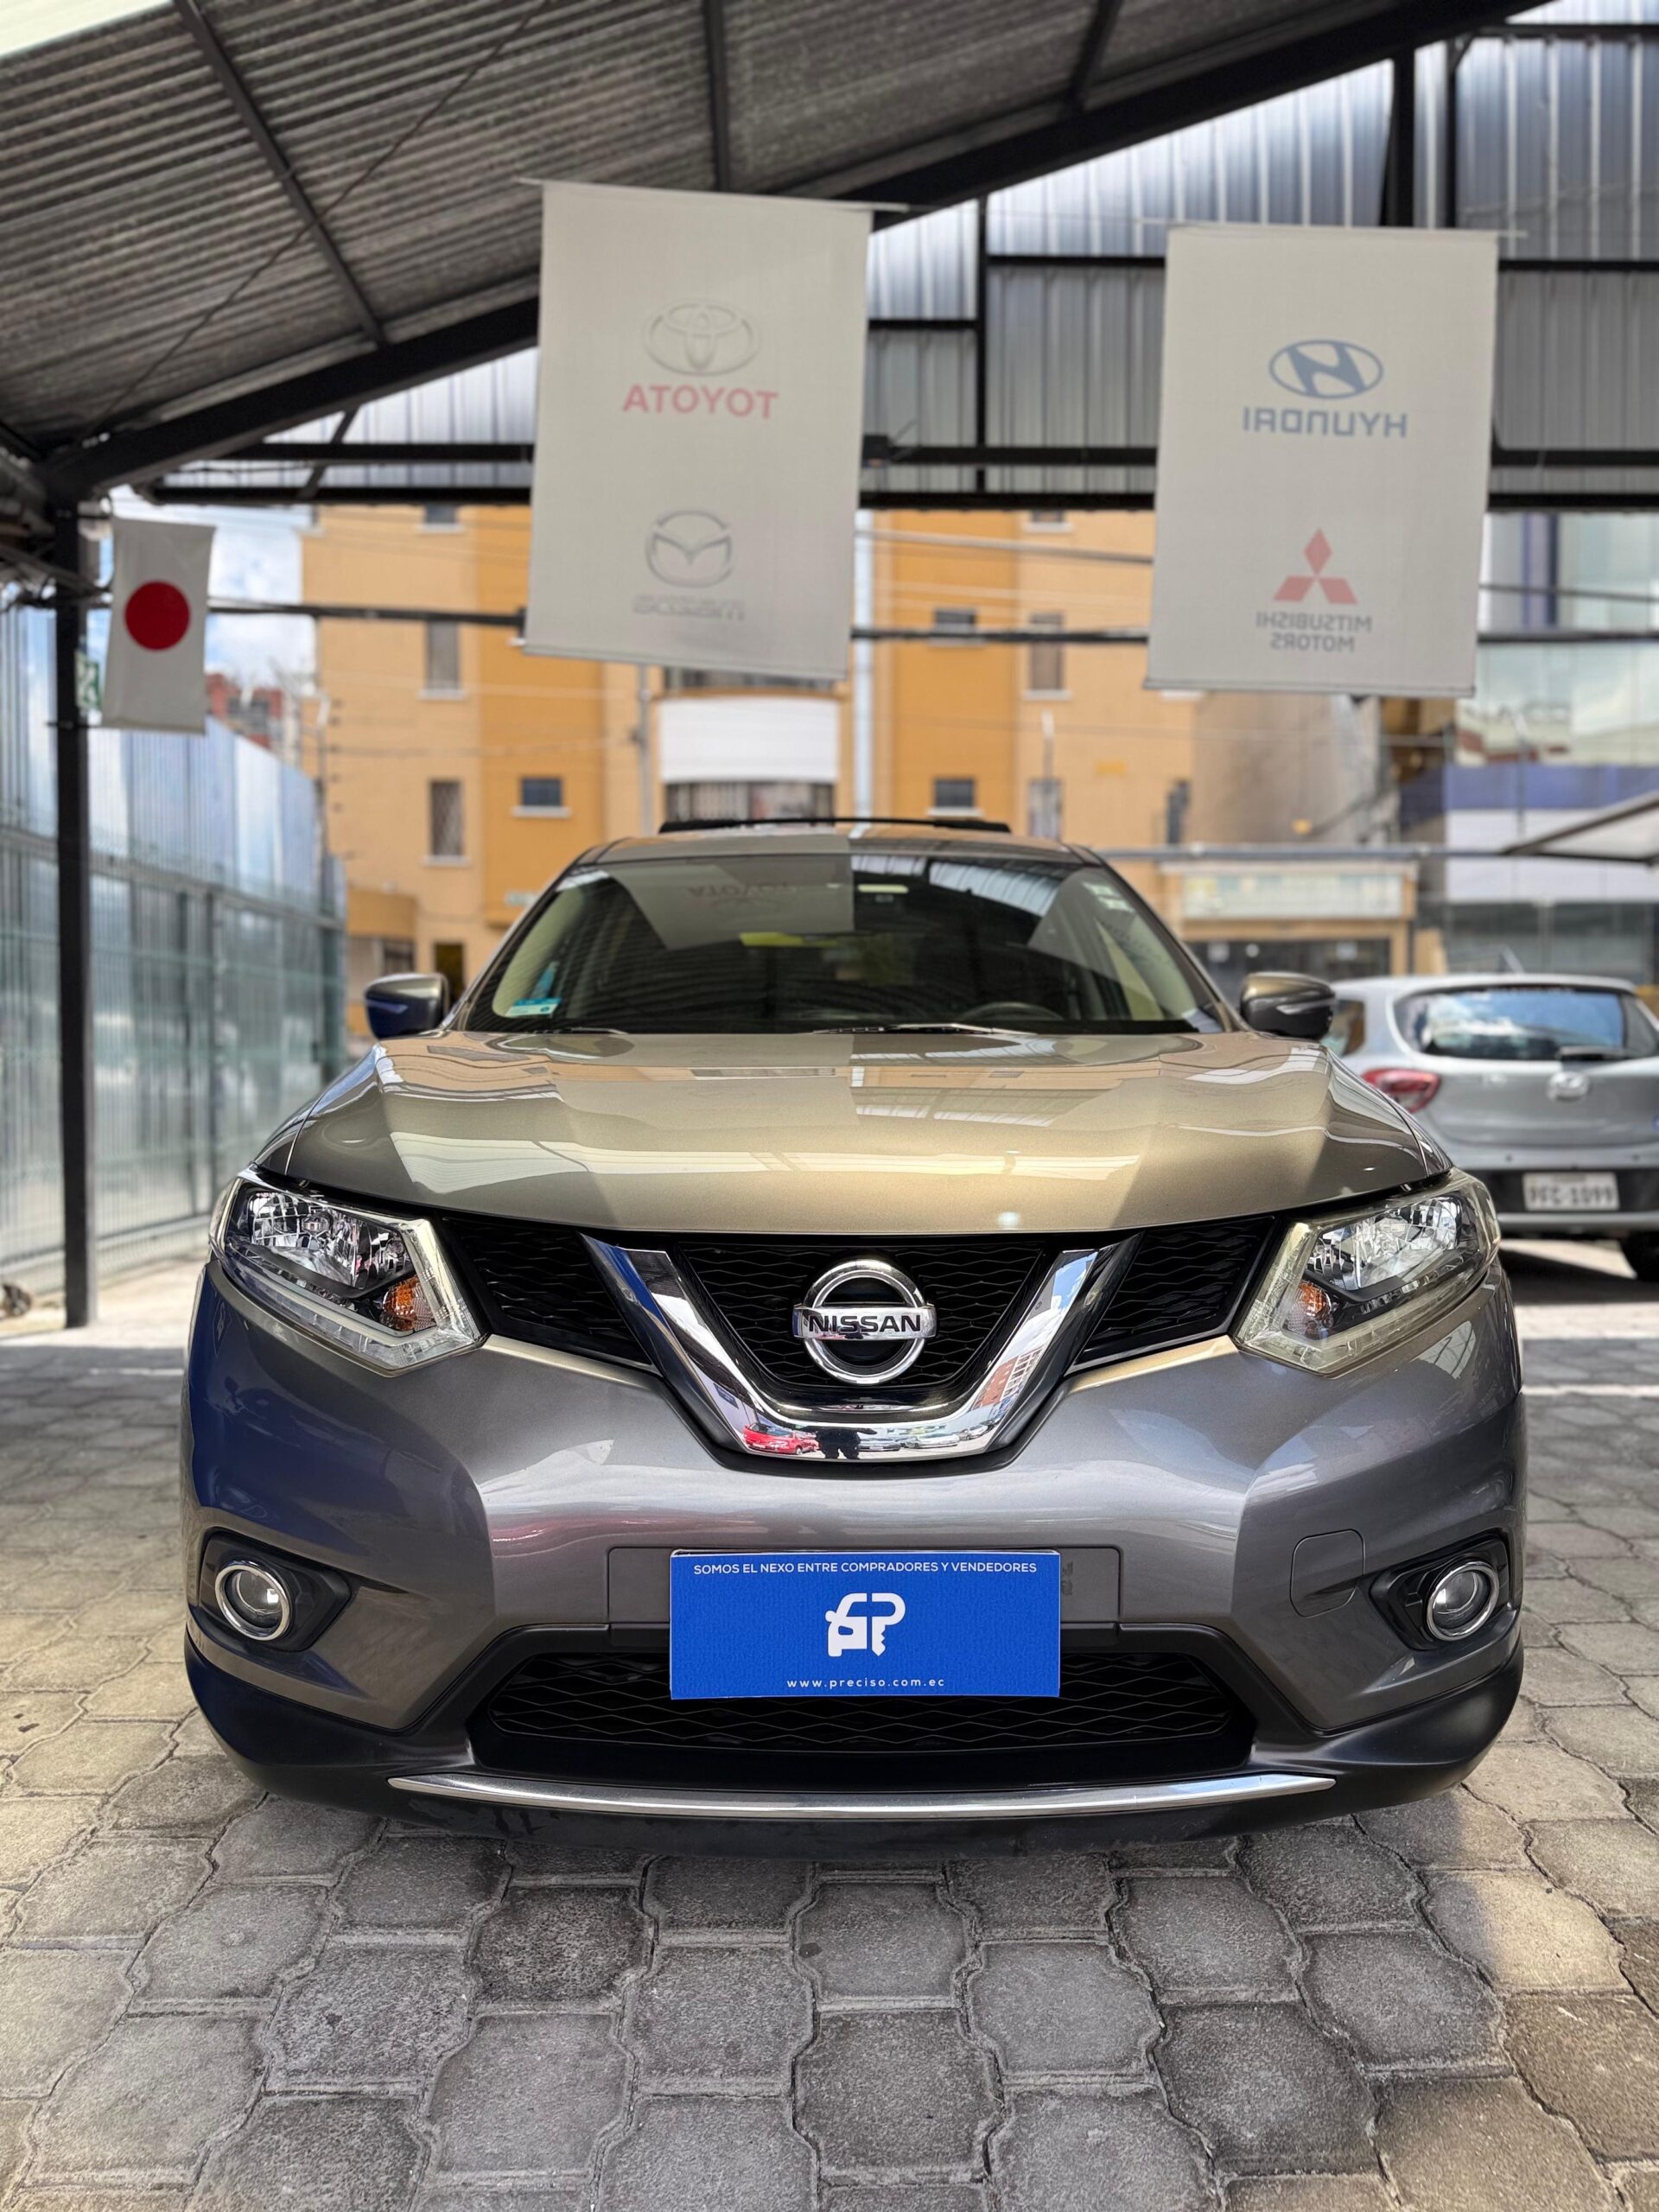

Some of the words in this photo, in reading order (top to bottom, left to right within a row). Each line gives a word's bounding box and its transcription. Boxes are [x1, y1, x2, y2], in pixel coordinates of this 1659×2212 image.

[808, 1314, 921, 1333] NISSAN
[694, 1563, 740, 1575] SOMOS
[742, 1563, 758, 1573] EL
[760, 1563, 795, 1573] NEXO
[798, 1562, 838, 1573] ENTRE
[841, 1561, 938, 1573] COMPRADORES
[941, 1562, 949, 1572] Y
[950, 1561, 1037, 1573] VENDEDORES
[786, 1677, 944, 1689] www.preciso.com.ec
